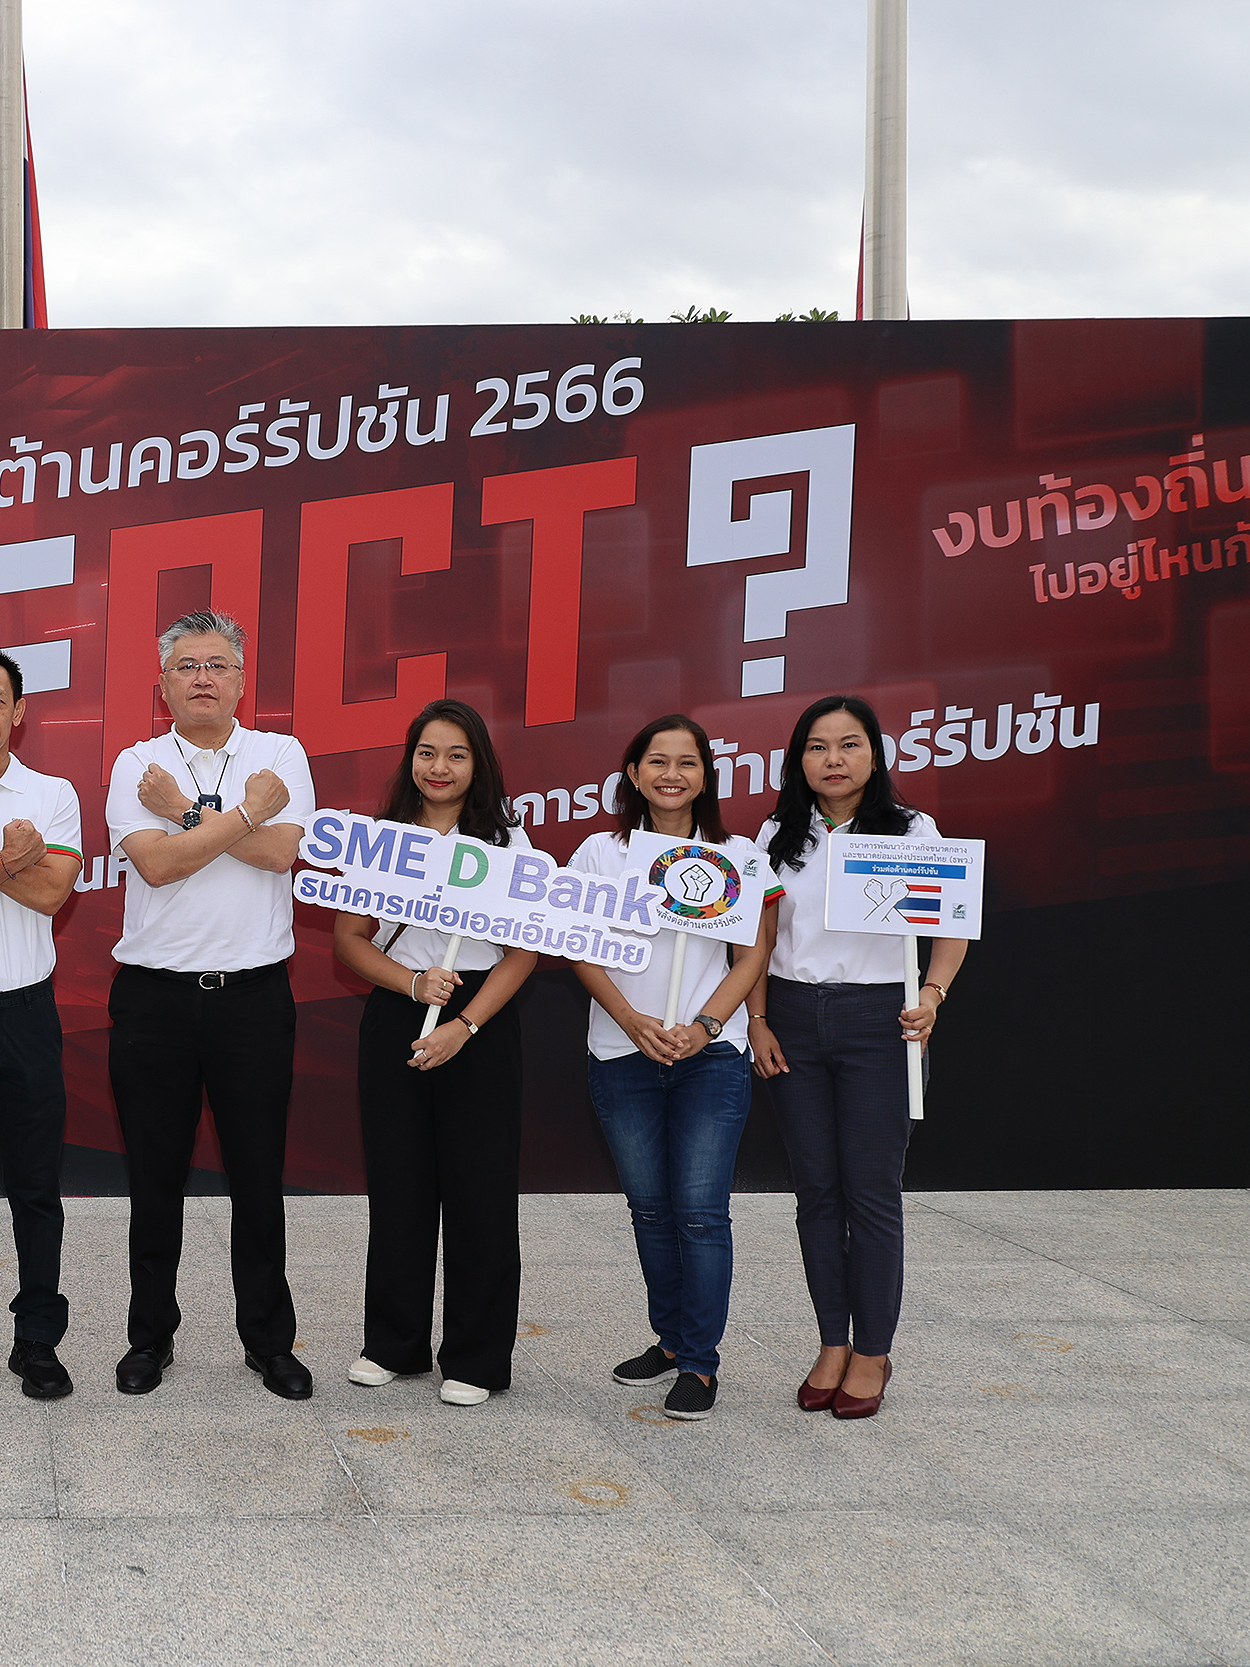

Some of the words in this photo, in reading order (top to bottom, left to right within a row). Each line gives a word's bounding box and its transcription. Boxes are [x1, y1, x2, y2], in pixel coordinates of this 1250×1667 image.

[469, 356, 645, 438] 2566
[307, 816, 434, 881] SME
[447, 842, 489, 889] D
[507, 853, 660, 928] Bank
[299, 876, 646, 967] ธนาคารเพื่อเอสเอ็มอีไทย
